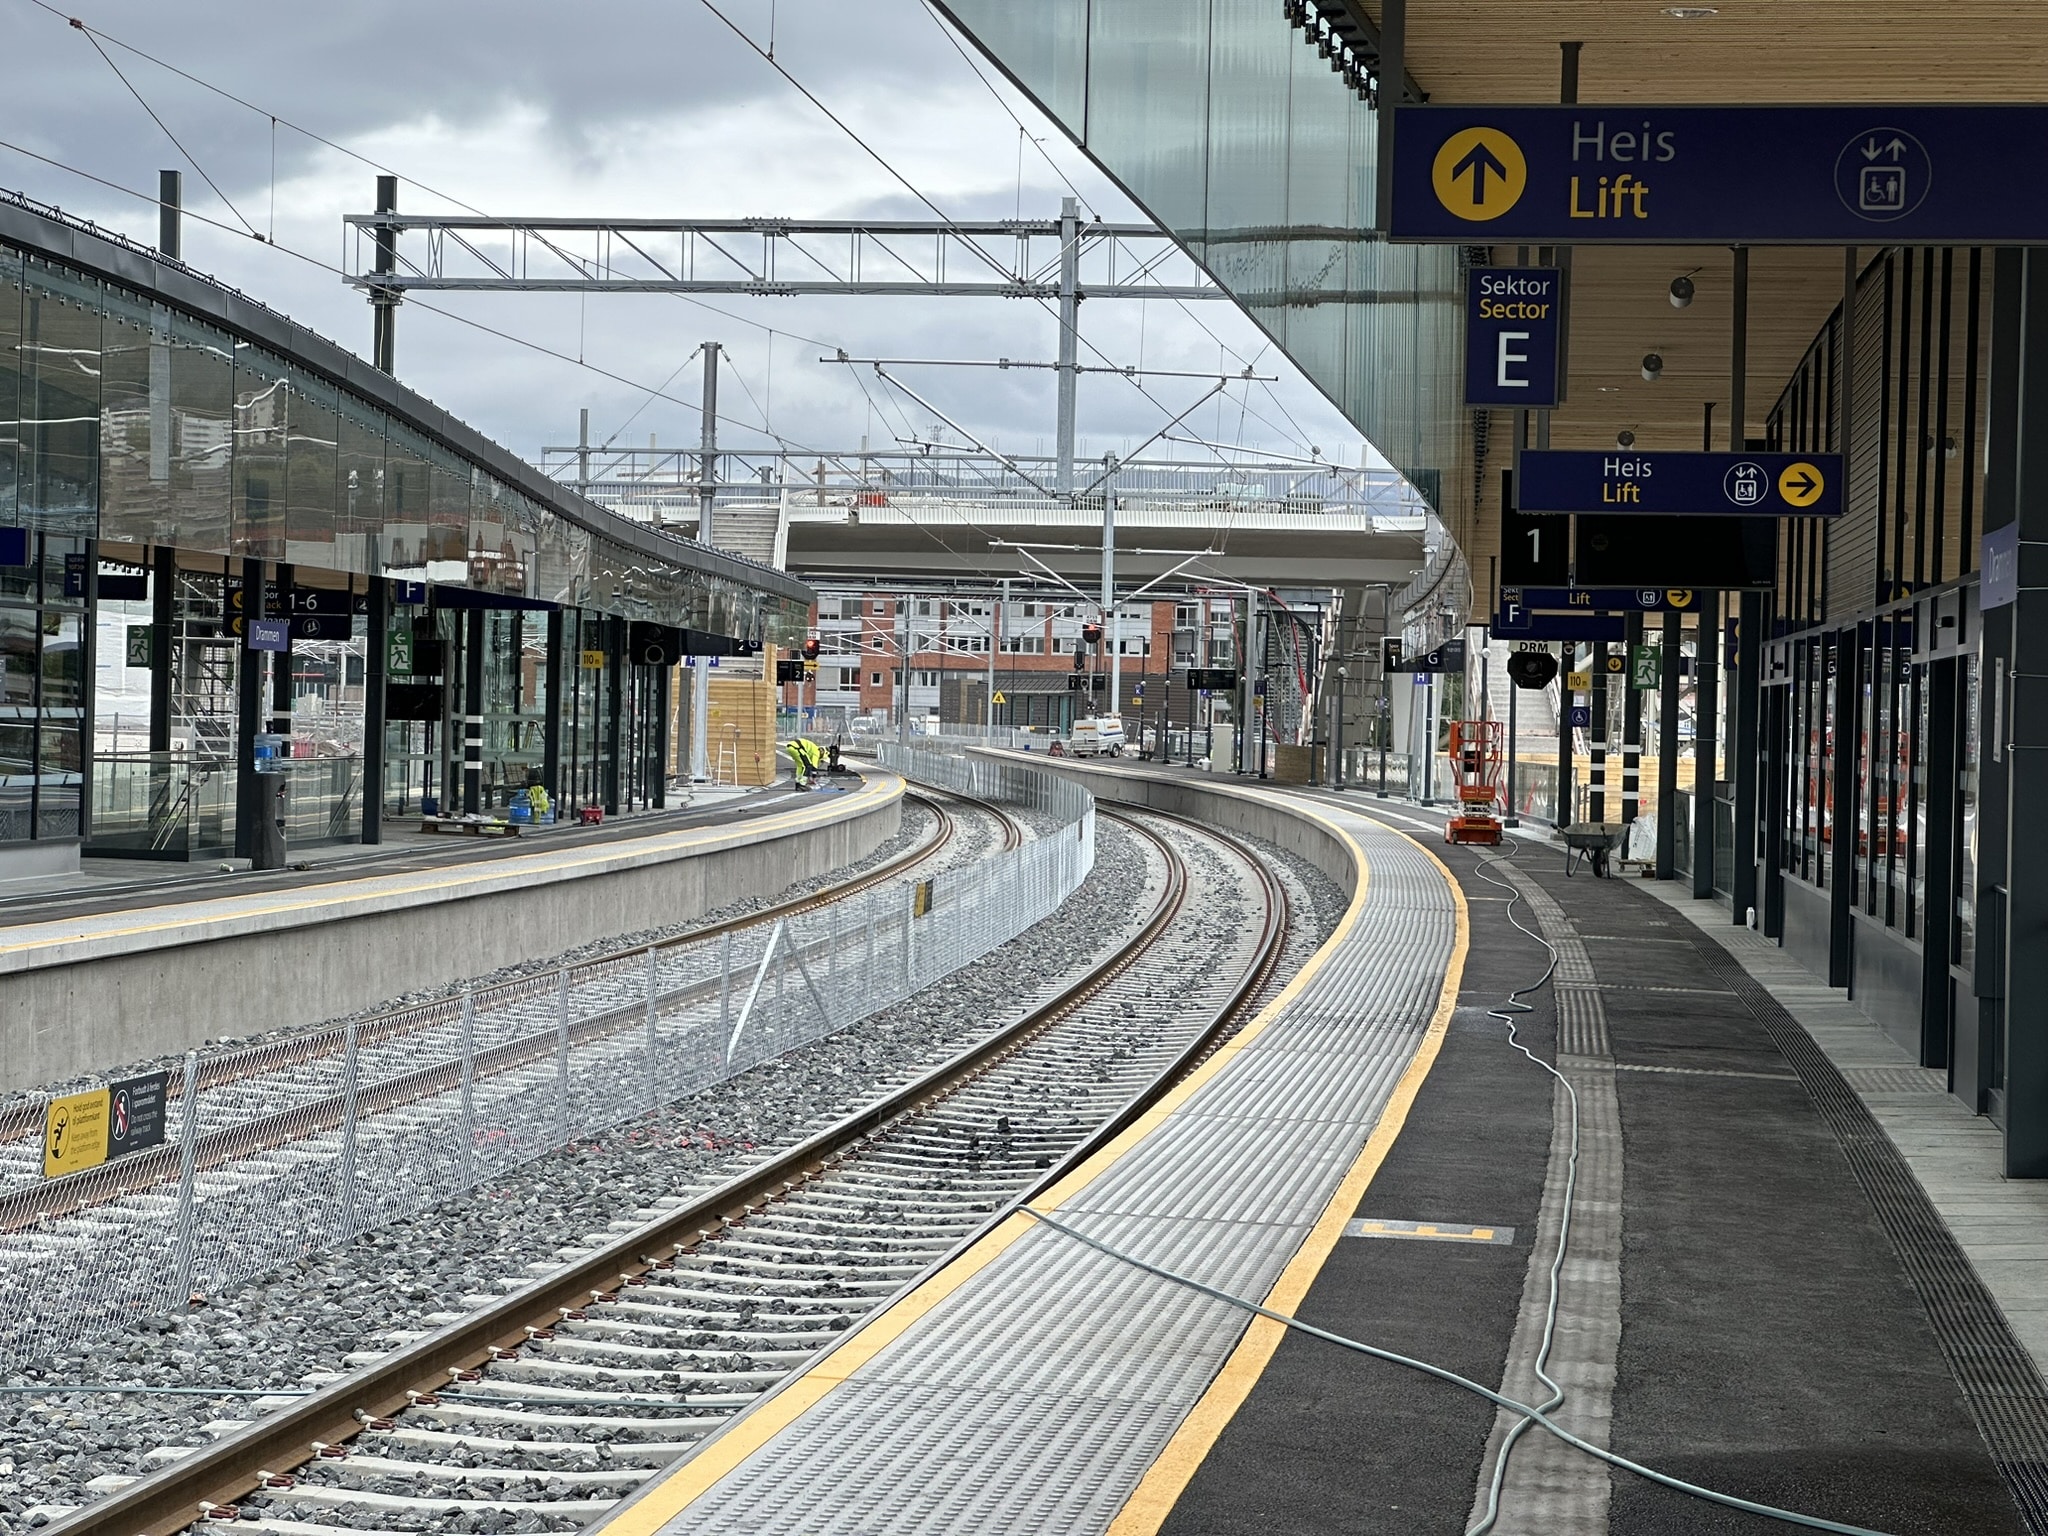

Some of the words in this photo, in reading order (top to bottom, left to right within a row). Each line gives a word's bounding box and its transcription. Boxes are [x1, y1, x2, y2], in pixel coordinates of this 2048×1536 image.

[1572, 121, 1676, 162] Heis
[1570, 174, 1649, 219] Lift
[1480, 275, 1550, 295] Sektor
[1479, 298, 1549, 319] Sector
[1497, 331, 1530, 387] E
[1603, 457, 1652, 477] Heis
[1602, 481, 1640, 502] Lift
[1527, 528, 1540, 563] 1
[265, 601, 281, 609] ack
[288, 594, 318, 610] 1-6
[1569, 592, 1591, 605] Lift
[1509, 604, 1520, 623] F
[255, 625, 280, 642] Drammen
[1519, 642, 1549, 653] DRM
[583, 655, 594, 664] 110
[1391, 655, 1396, 667] 1
[1428, 652, 1439, 665] G
[1417, 672, 1425, 682] H
[1569, 676, 1581, 686] 110
